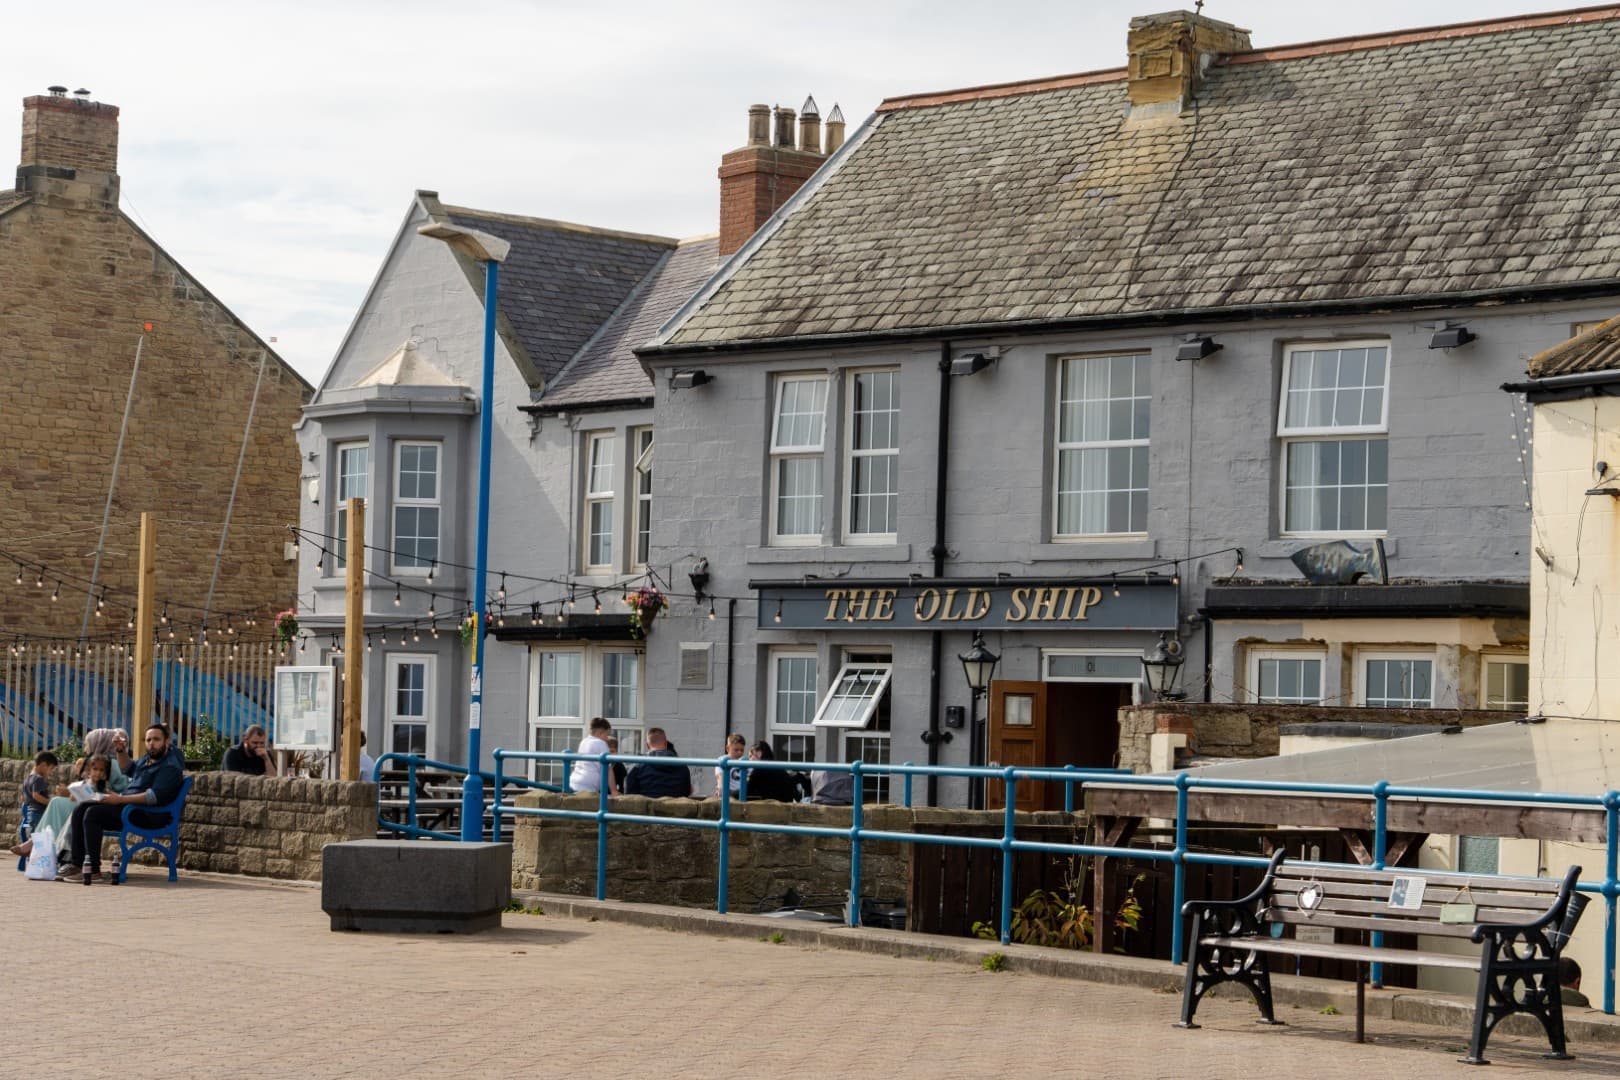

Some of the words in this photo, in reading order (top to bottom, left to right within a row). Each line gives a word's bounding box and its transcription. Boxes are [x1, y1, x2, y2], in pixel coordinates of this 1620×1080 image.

[824, 588, 897, 621] THE
[914, 588, 991, 621] OLD
[1005, 587, 1102, 621] SHIP
